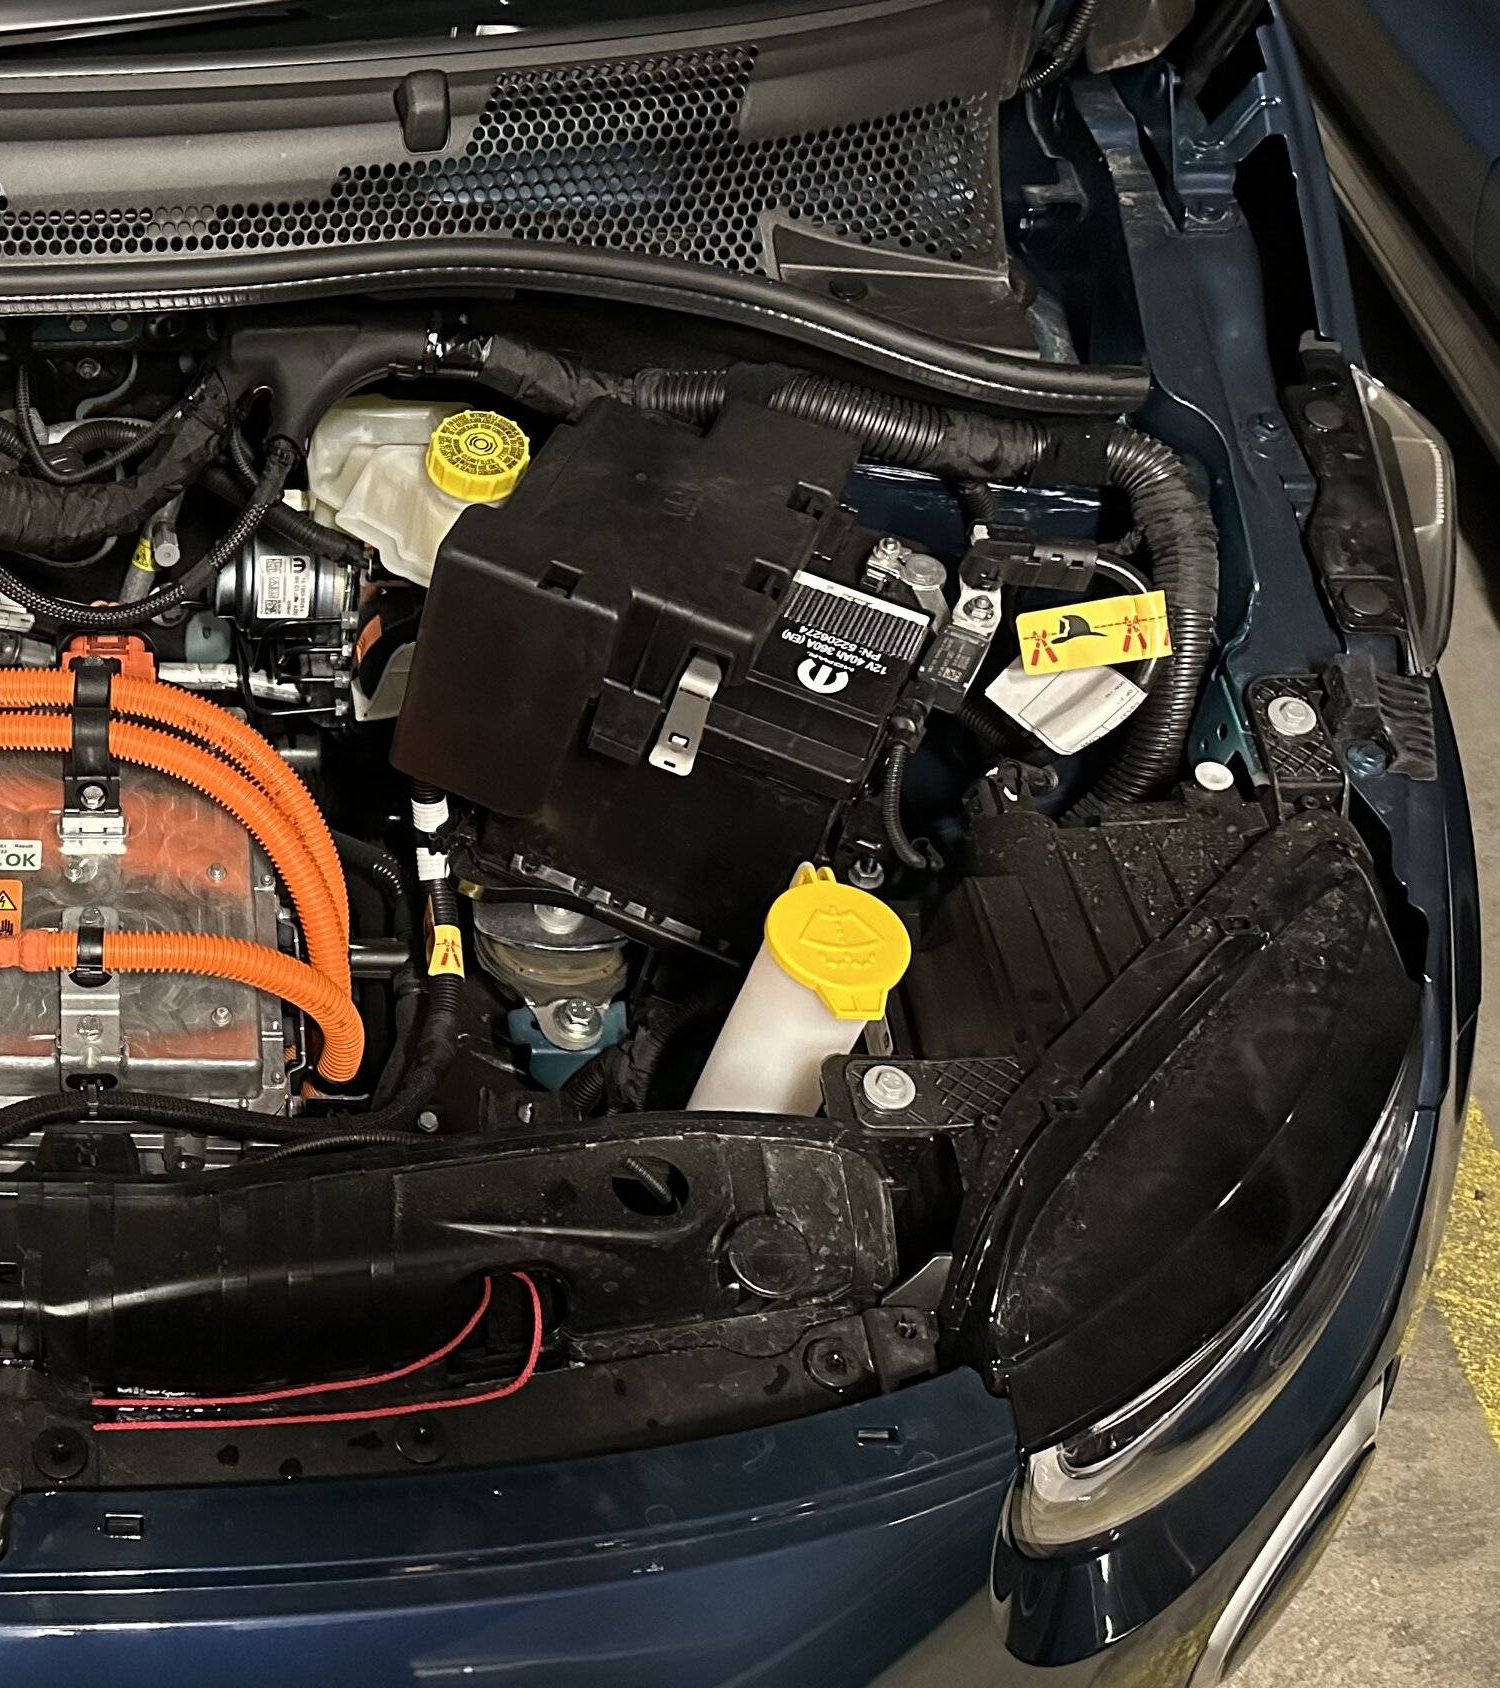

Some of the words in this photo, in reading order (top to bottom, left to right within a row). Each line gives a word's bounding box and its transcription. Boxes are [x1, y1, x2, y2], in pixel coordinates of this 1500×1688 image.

[781, 629, 806, 644] (EN)
[808, 638, 835, 655] 360A
[836, 650, 866, 666] 40Ah
[864, 661, 888, 675] 12V
[5, 853, 36, 867] OK
